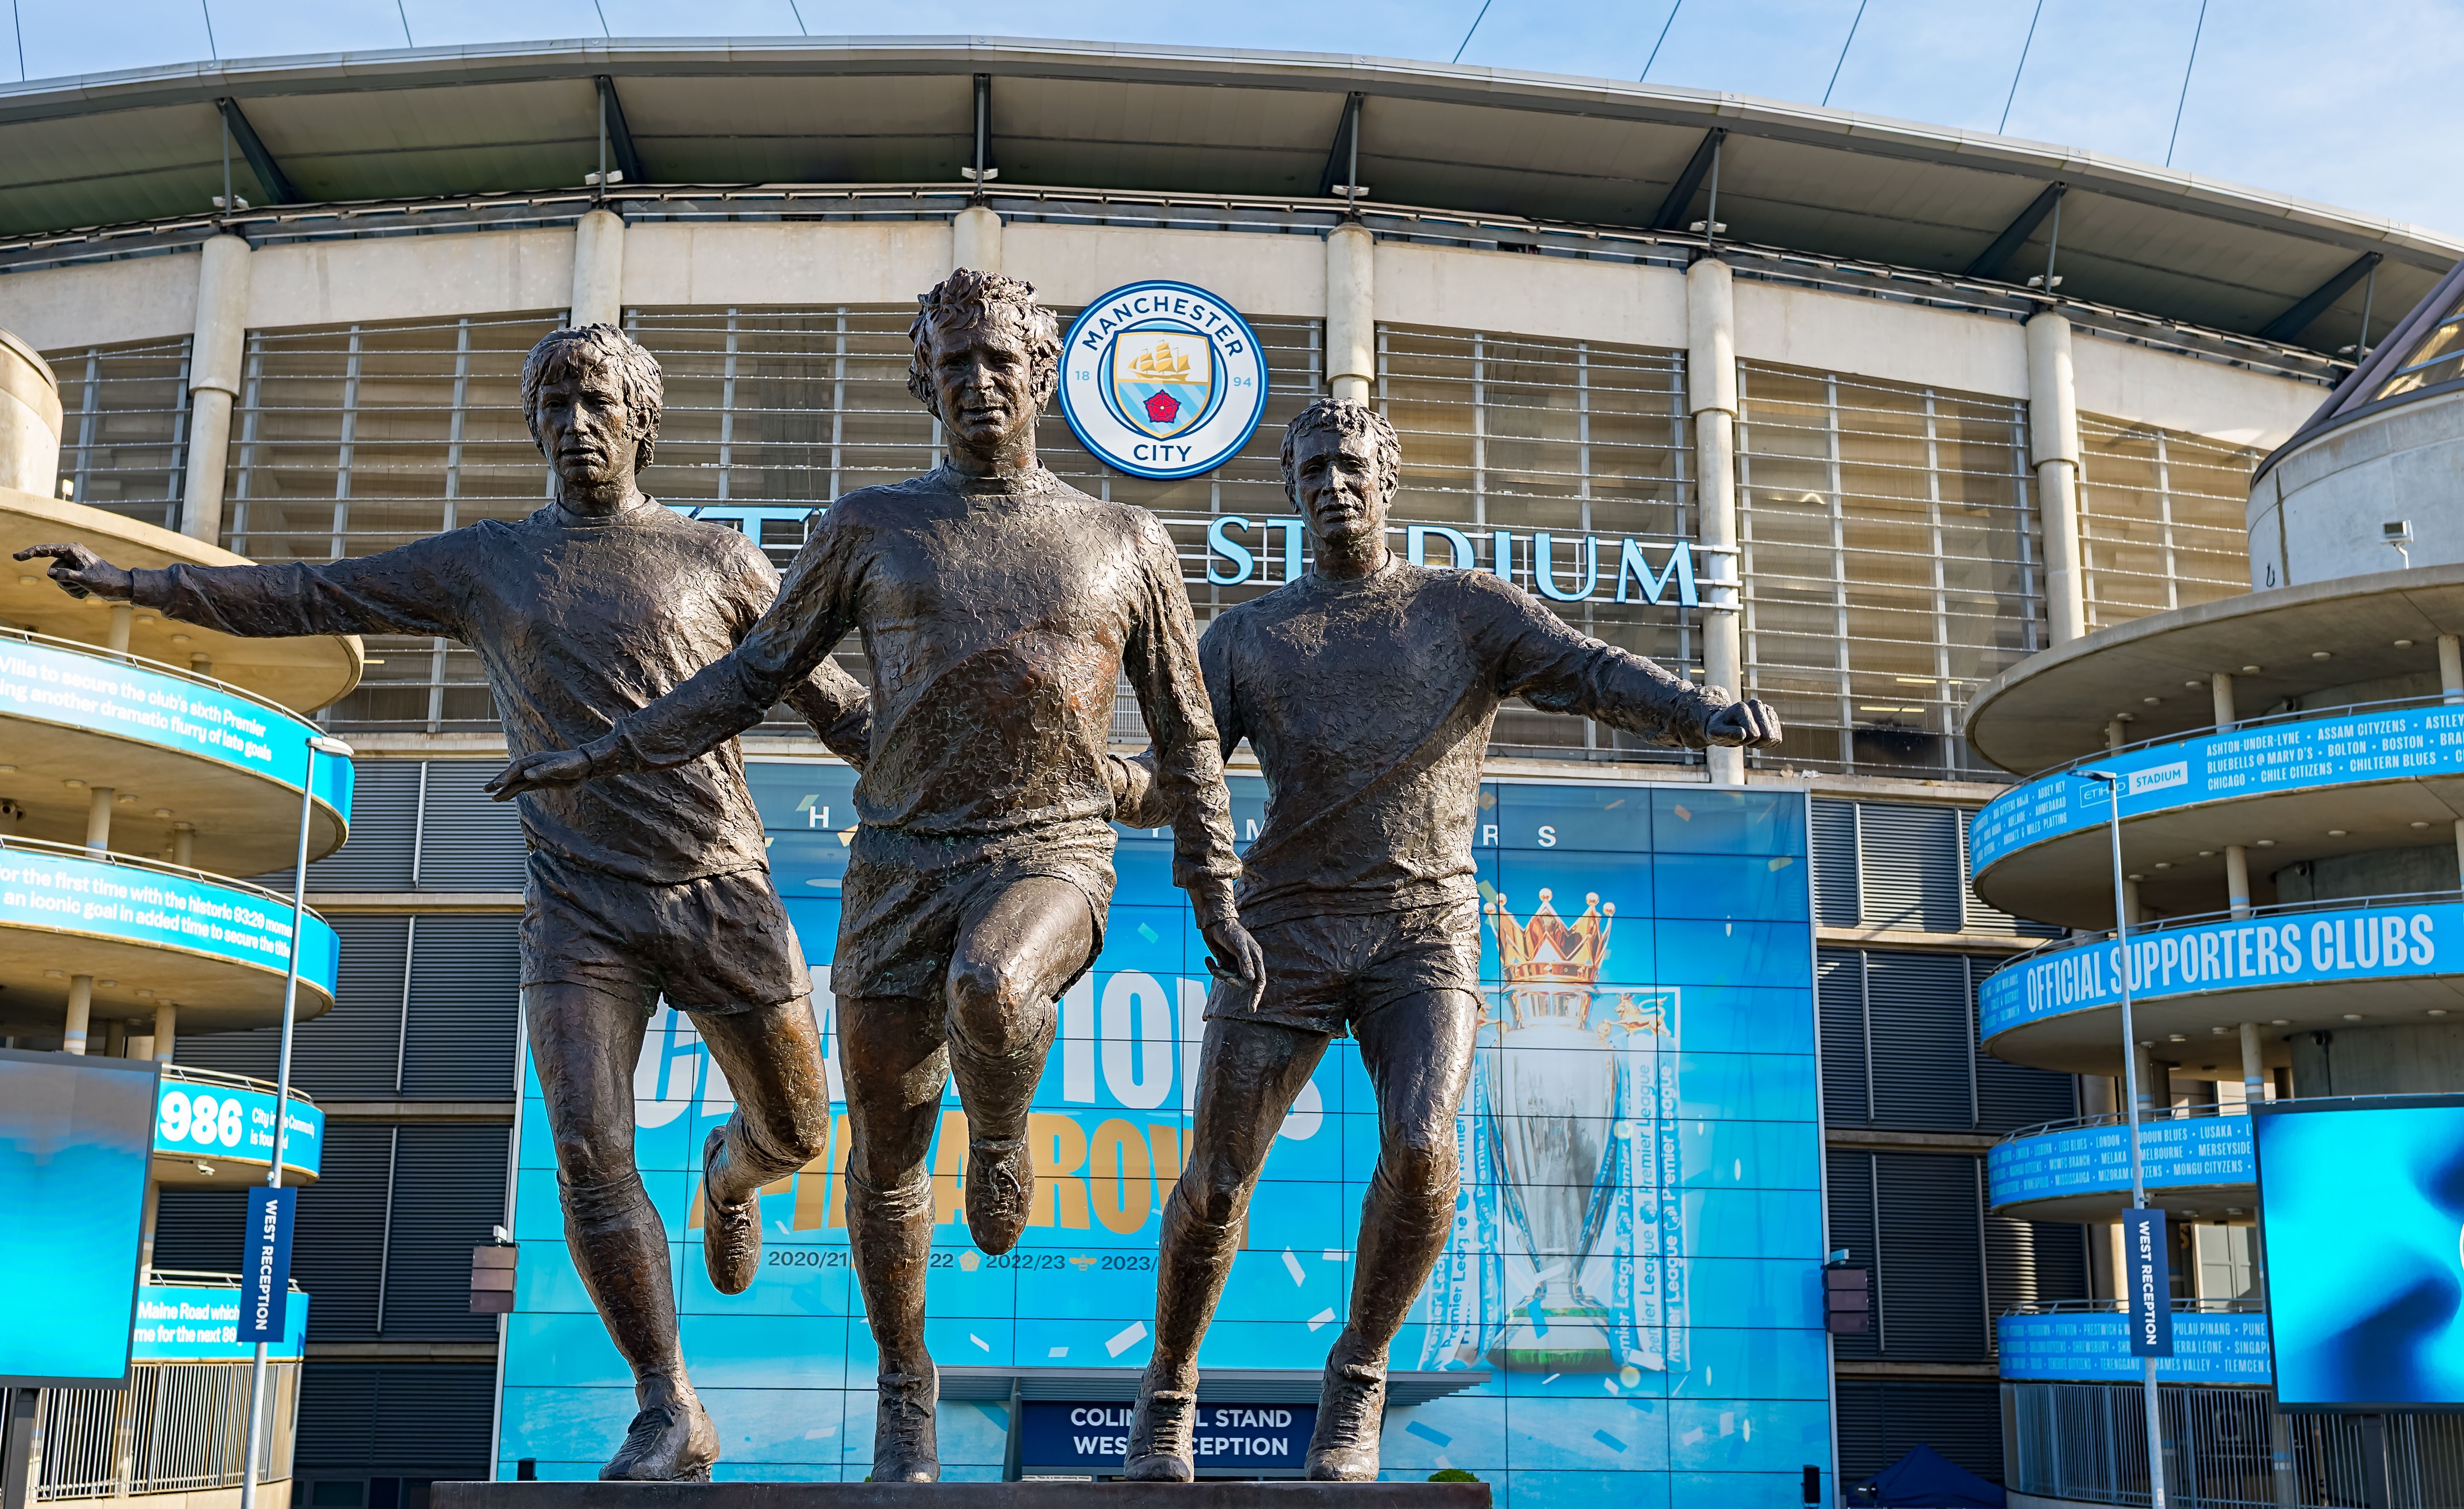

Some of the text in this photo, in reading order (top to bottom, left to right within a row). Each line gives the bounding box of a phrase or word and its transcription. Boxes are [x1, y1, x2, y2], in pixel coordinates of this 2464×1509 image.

[1082, 296, 1243, 357] MANCHESTER
[1075, 371, 1252, 387] 18 94
[1134, 444, 1192, 462] CITY
[1208, 515, 1699, 608] STDIUM
[0, 655, 266, 738] Villa to secure the club's sixth Premier
[0, 678, 272, 761] ing another dramatic flurry of late goals
[2207, 731, 2299, 757] ASHTON-UNDER-LYNE
[2318, 724, 2354, 741] ASSAM
[2358, 719, 2406, 736] CITYZENS
[2208, 754, 2254, 774] BLUEBELLS
[2257, 754, 2265, 766] @
[2267, 749, 2294, 765] MARY
[2328, 741, 2366, 757] BOLTON
[2382, 735, 2423, 751] BOSTON
[2137, 769, 2180, 787] STADIUM
[2208, 773, 2245, 790] CHICAGO
[2261, 767, 2287, 782] CHILE
[2290, 762, 2332, 779] CITIZENS
[2350, 755, 2399, 772] CHILTERN
[2403, 751, 2436, 767] BLUES
[2038, 784, 2053, 800] ABBEY
[2084, 782, 2125, 800] ETIHD
[2036, 796, 2066, 817] AHMEDABAD
[2043, 812, 2067, 829] PLATTING
[0, 863, 20, 882] or
[22, 868, 51, 887] the
[55, 871, 90, 893] first
[92, 878, 127, 899] time
[130, 886, 163, 906] with
[165, 891, 186, 910] the
[188, 895, 232, 921] historic
[3, 891, 26, 907] an
[29, 890, 81, 914] iconic
[83, 902, 117, 920] goal
[119, 904, 133, 923] in
[135, 910, 179, 932] added
[181, 916, 210, 938] time
[210, 923, 223, 940] to
[224, 929, 258, 949] secure
[259, 935, 274, 954] the
[2027, 914, 2435, 1013] OFFICIAL SUPPORTERS CLUBS
[160, 1091, 243, 1148] 986
[252, 1107, 269, 1129] City
[1636, 1064, 1654, 1194] Premier League
[250, 1128, 258, 1145] is
[1660, 1065, 1676, 1201] Premier League
[2070, 1137, 2087, 1151] BLUES
[2096, 1134, 2120, 1148] LONDON
[2164, 1128, 2187, 1142] BLUES
[2200, 1124, 2232, 1139] LUSAKA
[2101, 1150, 2127, 1164] MELAKA
[2140, 1146, 2183, 1161] MELBOURNE
[2198, 1141, 2251, 1156] MERSEYSIDE
[2098, 1168, 2129, 1182] MIZORAM
[2174, 1162, 2202, 1176] MONGU
[2204, 1159, 2243, 1174] CITYZENS
[255, 1199, 278, 1330] WEST RECEPTION
[768, 1251, 1158, 1273] 2020/21 2022/23 2023/
[1614, 1243, 1633, 1308] League
[1640, 1230, 1659, 1295] League
[1665, 1235, 1683, 1302] League
[2139, 1221, 2157, 1345] WEST RECEPTION
[138, 1301, 240, 1321] Maine Road which
[1441, 1286, 1463, 1348] Premier
[157, 1325, 175, 1342] for
[176, 1326, 196, 1342] the
[196, 1327, 221, 1342] next
[2174, 1323, 2198, 1335] PULAU
[2200, 1323, 2230, 1335] PINANG
[2243, 1323, 2265, 1336] PUNE
[2174, 1341, 2196, 1353] IERRA
[2198, 1341, 2222, 1353] LEONE
[2235, 1341, 2270, 1354] SINGAP
[2100, 1358, 2140, 1370] TERENGGANU
[2155, 1358, 2180, 1371] HAMES
[2183, 1358, 2210, 1371] VALLEY
[2225, 1359, 2264, 1372] TLEMCEN
[1216, 1410, 1292, 1427] STAND
[1073, 1436, 1127, 1455] WES
